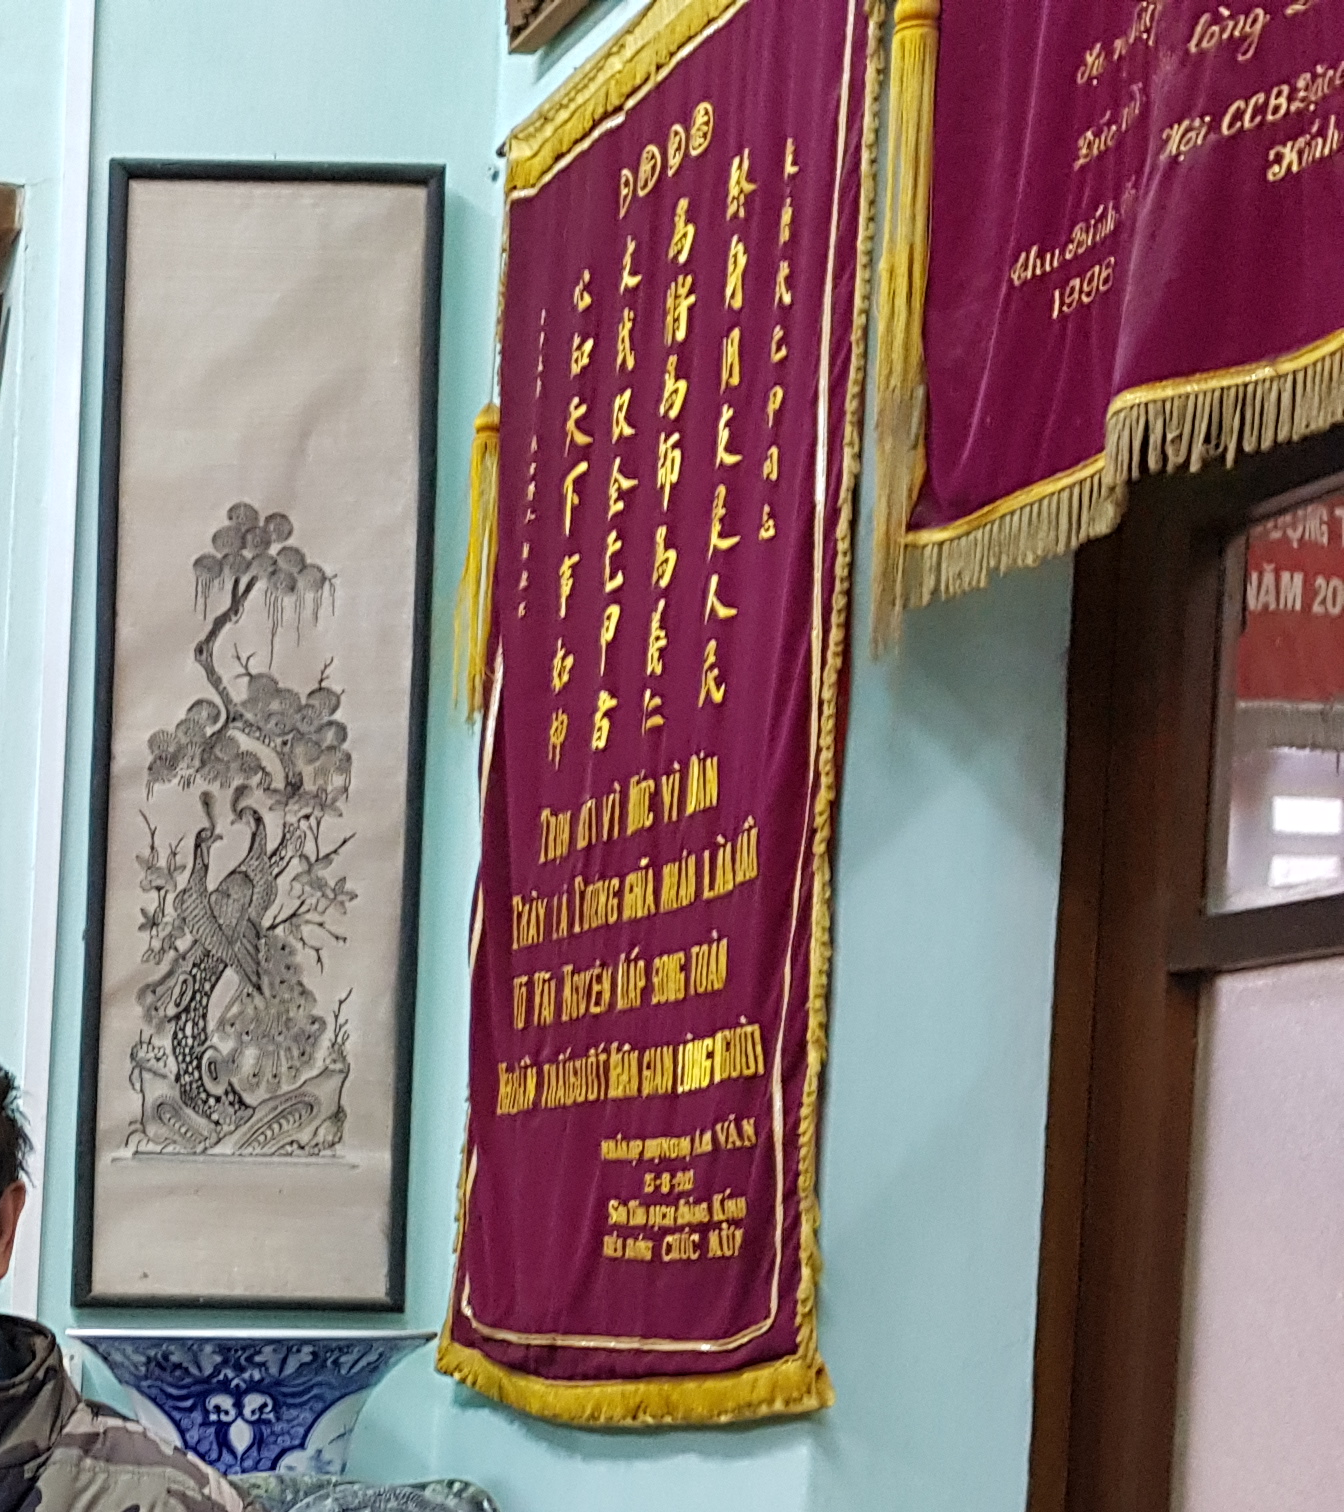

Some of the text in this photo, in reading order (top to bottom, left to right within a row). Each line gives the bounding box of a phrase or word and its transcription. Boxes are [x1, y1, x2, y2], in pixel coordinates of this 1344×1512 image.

[1188, 6, 1270, 61] lòng
[1160, 115, 1211, 162] Hội
[1221, 84, 1290, 136] CCB
[1266, 115, 1340, 182] Kính
[1312, 574, 1344, 616] 20
